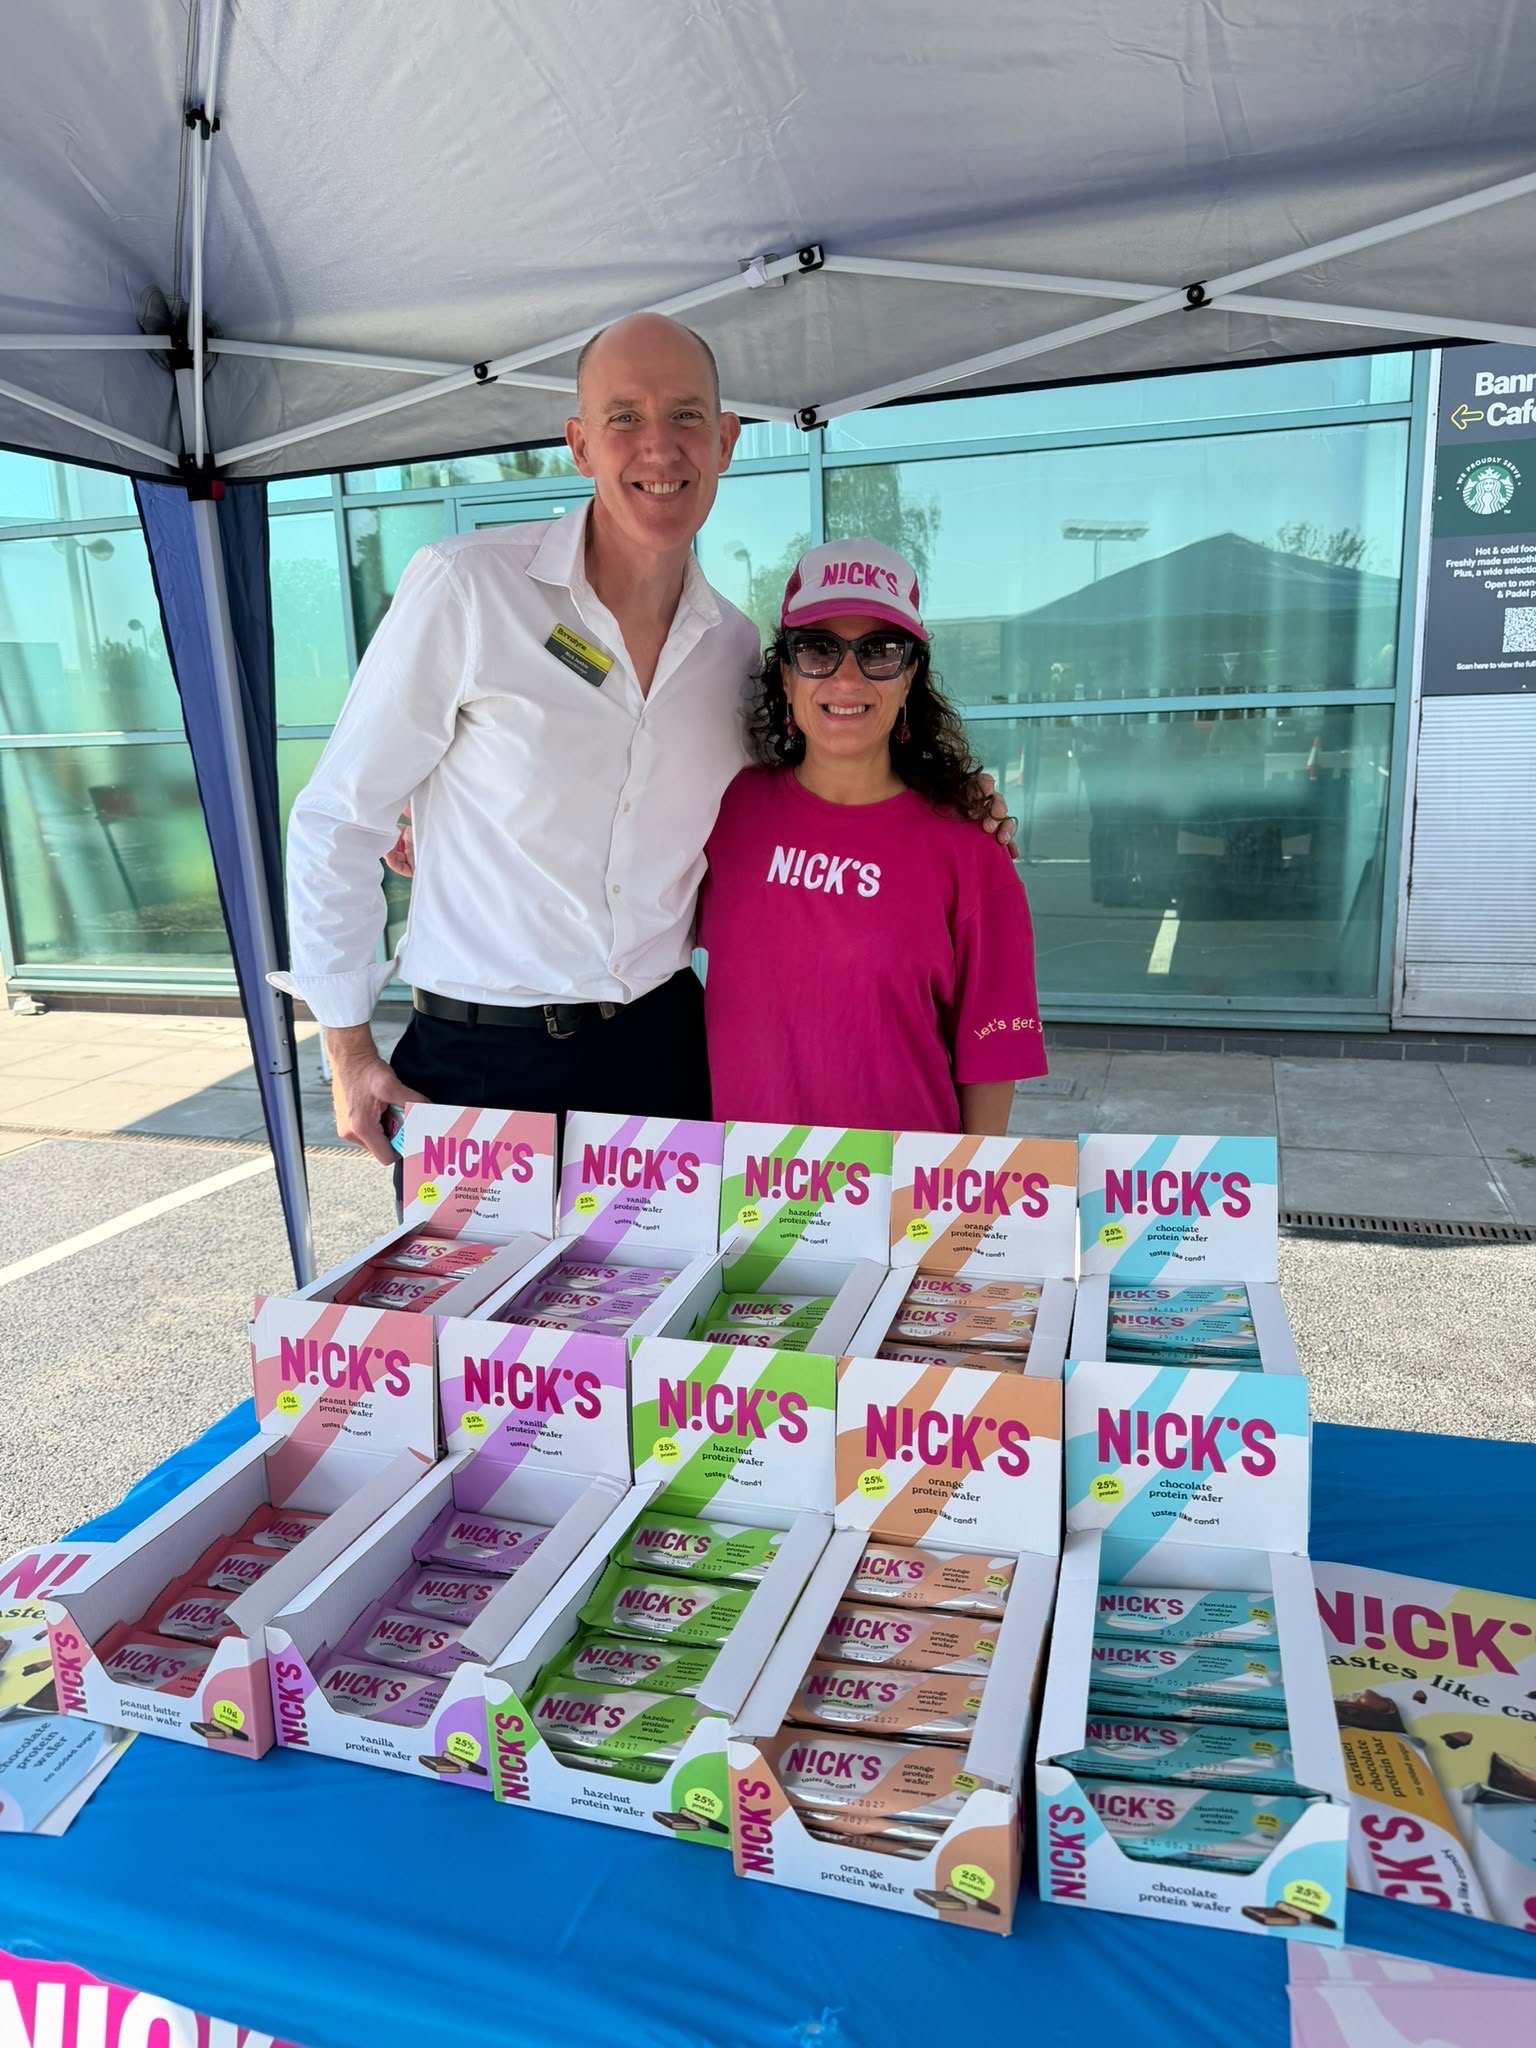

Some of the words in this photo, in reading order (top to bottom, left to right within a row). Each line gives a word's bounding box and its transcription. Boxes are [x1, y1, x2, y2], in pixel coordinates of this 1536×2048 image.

[1457, 473, 1467, 484] WE
[1466, 457, 1501, 472] PROUDLY
[1503, 460, 1521, 479] SERVE
[1476, 548, 1491, 556] Hot
[1492, 546, 1499, 554] &
[1501, 545, 1519, 554] cold
[1446, 558, 1476, 568] Freshly
[1478, 557, 1501, 566] made
[1454, 569, 1474, 577] Plus,
[1483, 567, 1502, 576] wide
[1485, 581, 1506, 590] Open
[1505, 589, 1529, 598] Padel
[974, 1018, 1006, 1040] let's
[1012, 1017, 1035, 1030] get
[580, 1196, 594, 1204] 25%
[743, 1210, 757, 1218] 25%
[788, 1208, 822, 1218] hazelnut
[779, 1216, 808, 1225] protein
[809, 1218, 831, 1226] wafer
[964, 1223, 993, 1232] orange
[1105, 1228, 1122, 1236] 25%
[1156, 1224, 1199, 1233] chocolate
[951, 1230, 981, 1239] protein
[983, 1232, 1007, 1241] wafer
[1147, 1232, 1179, 1242] protein
[1182, 1234, 1208, 1243] wafer
[283, 1396, 296, 1404] 10g
[319, 1395, 347, 1406] peanut
[349, 1398, 373, 1409] butter
[319, 1405, 348, 1416] protein
[350, 1409, 373, 1418] wafer
[519, 1418, 548, 1429] vanilla
[506, 1425, 537, 1436] protein
[539, 1430, 563, 1440] wafer
[659, 1443, 676, 1451] 25%
[713, 1443, 753, 1456] hazelnut
[702, 1453, 735, 1464] protein
[737, 1457, 764, 1467] wafer
[864, 1476, 883, 1484] 25%
[928, 1477, 964, 1490] orange
[1097, 1480, 1117, 1490] 25%
[1159, 1479, 1212, 1491] chocolate
[912, 1486, 949, 1499] protein
[951, 1491, 981, 1502] wafer
[1149, 1490, 1188, 1501] protein
[1191, 1492, 1223, 1503] wafer
[914, 1507, 938, 1515] tastes
[939, 1510, 952, 1520] like
[953, 1516, 977, 1525] candy
[1152, 1509, 1177, 1518] tastes
[1178, 1511, 1193, 1523] like
[1194, 1517, 1219, 1526] candy
[1327, 1655, 1418, 1680] astes
[1430, 1674, 1490, 1708] like
[120, 1698, 151, 1713] peanut
[153, 1704, 181, 1718] butter
[222, 1705, 238, 1719] 10g
[121, 1708, 154, 1723] protein
[155, 1717, 182, 1729] wafer
[642, 1714, 675, 1723] hazelnut
[642, 1721, 669, 1729] protein
[642, 1727, 664, 1735] wafer
[76, 1730, 96, 1748] sugar
[360, 1735, 394, 1748] vanilla
[455, 1738, 475, 1751] 25%
[1372, 1736, 1387, 1755] bar
[16, 1731, 59, 1770] protein
[33, 1736, 68, 1767] wafer
[345, 1741, 381, 1758] protein
[383, 1750, 412, 1762] wafer
[904, 1763, 935, 1772] orange
[1340, 1742, 1365, 1786] caramel
[1358, 1740, 1384, 1792] chocolate
[902, 1770, 934, 1779] protein
[1380, 1759, 1407, 1798] protein
[823, 1778, 835, 1787] like
[904, 1778, 930, 1786] wafer
[583, 1787, 631, 1804] hazelnut
[694, 1793, 716, 1807] 25%
[571, 1796, 610, 1812] protein
[613, 1805, 645, 1818] wafer
[840, 1863, 884, 1880] orange
[961, 1869, 986, 1886] 25%
[820, 1872, 865, 1888] protein
[869, 1881, 905, 1895] wafer
[958, 1879, 985, 1894] protein
[1152, 1882, 1218, 1900] chocolate
[1294, 1884, 1322, 1901] 25%
[1139, 1892, 1188, 1908] protein
[1192, 1900, 1232, 1914] wafer
